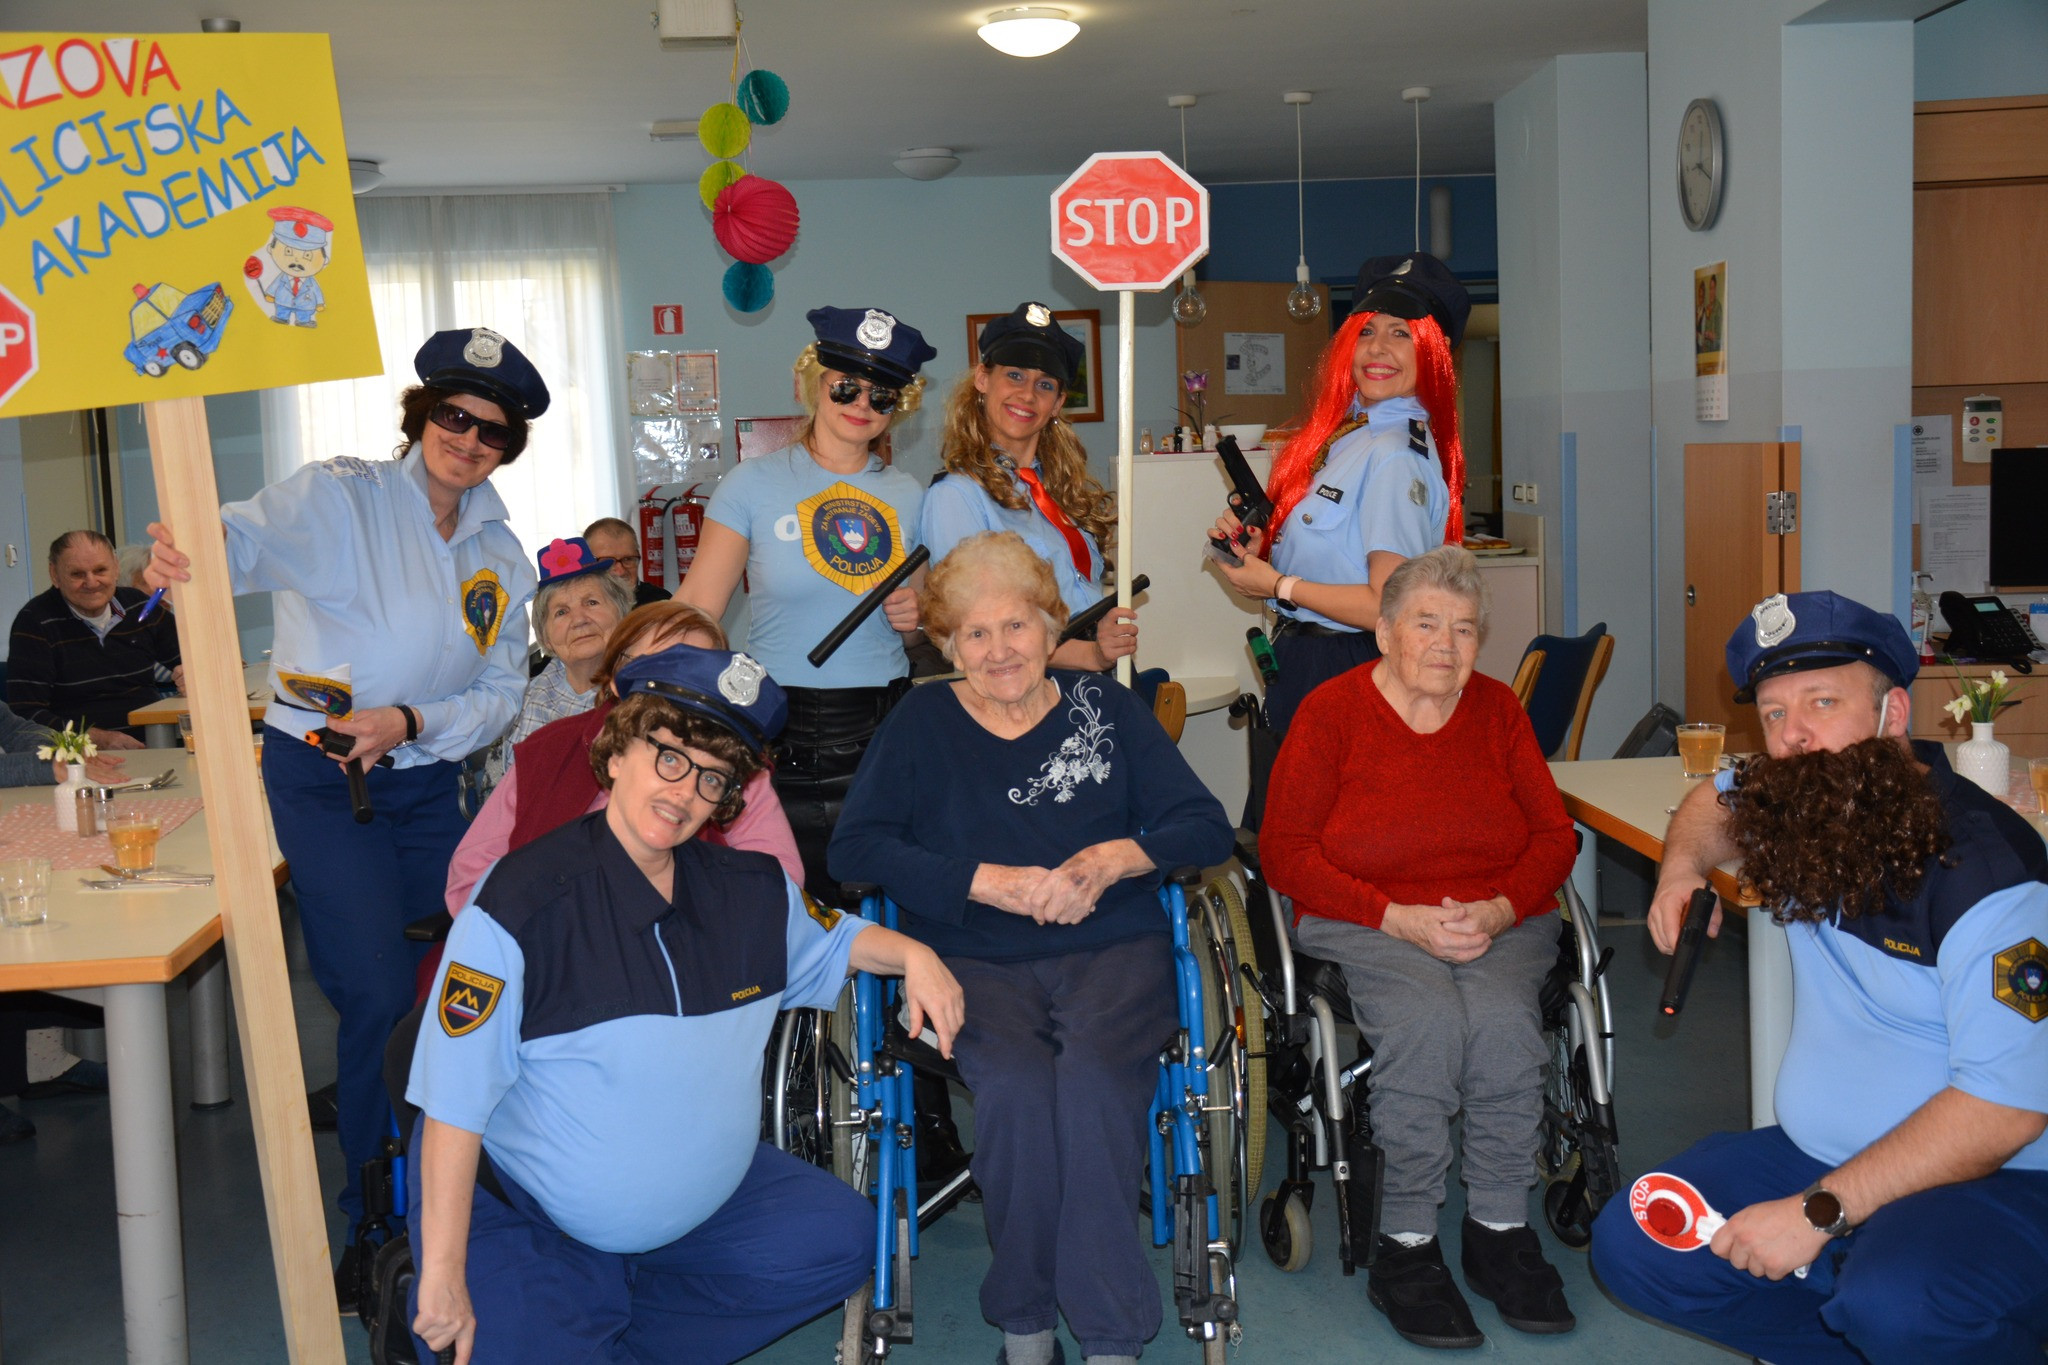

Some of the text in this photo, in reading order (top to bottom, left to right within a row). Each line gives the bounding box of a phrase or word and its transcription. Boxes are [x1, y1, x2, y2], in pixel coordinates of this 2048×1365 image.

[0, 38, 181, 110] ZOVA
[0, 88, 252, 229] LICIJSKA
[31, 126, 326, 295] AKADEMIJA
[1065, 196, 1194, 248] STOP
[1318, 486, 1339, 500] POLICE
[822, 500, 870, 511] MINISTRSTVO
[858, 509, 883, 533] ZADEVE
[830, 555, 884, 574] POLICIJA
[1884, 937, 1921, 957] POLICIJA
[452, 969, 495, 990] POLICIJA
[731, 985, 761, 1001] POLICIJA
[1630, 1180, 1651, 1221] STOP
